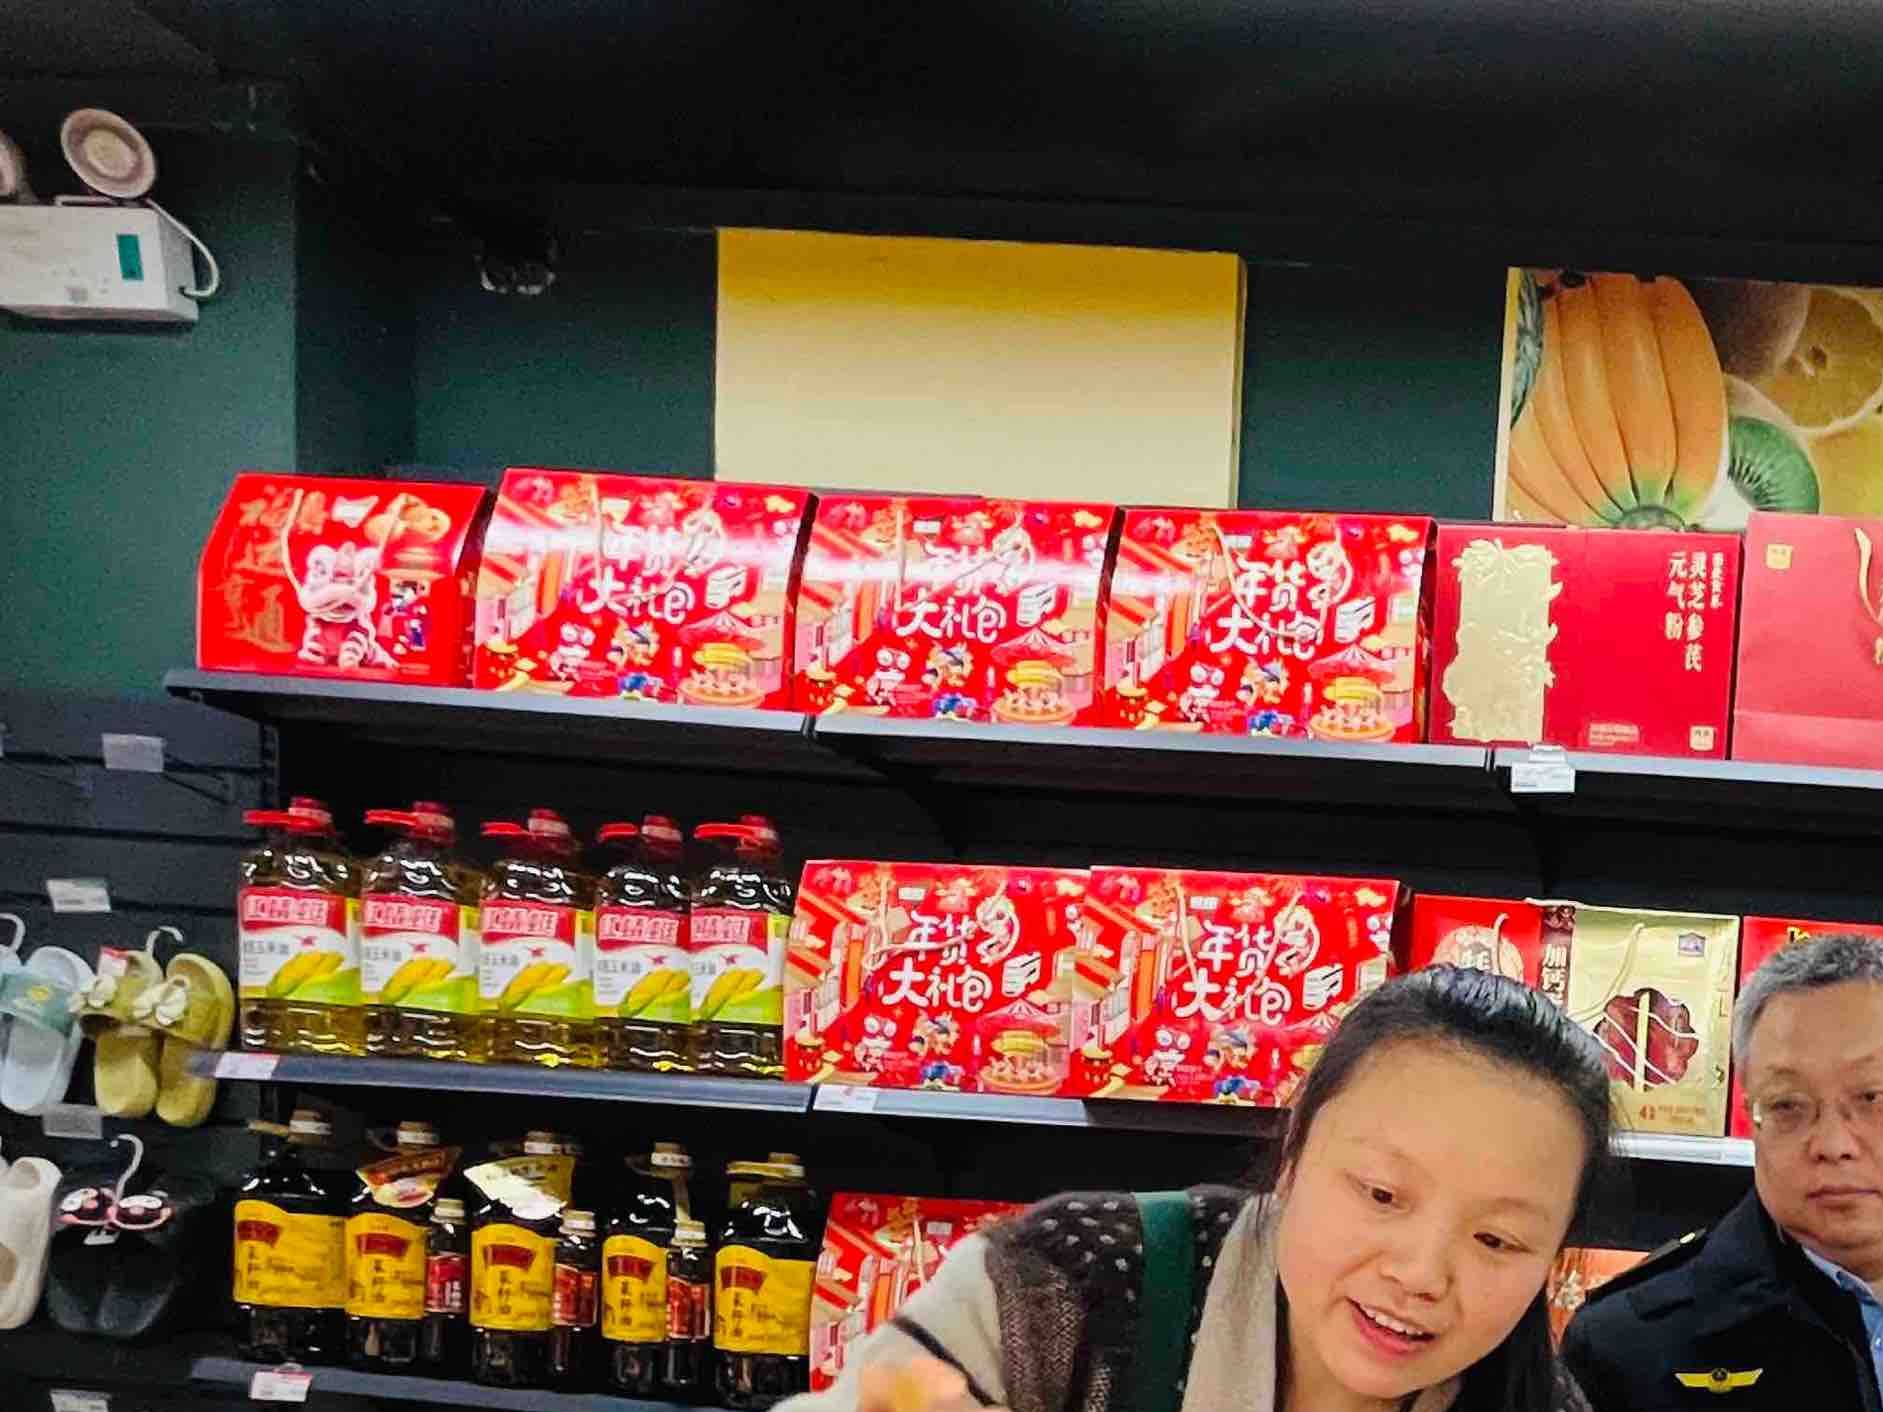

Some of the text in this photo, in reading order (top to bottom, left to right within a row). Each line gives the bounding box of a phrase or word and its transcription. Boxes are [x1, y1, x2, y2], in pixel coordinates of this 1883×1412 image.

[1238, 558, 1310, 613] 年货
[1665, 552, 1688, 640] 元气粉
[897, 595, 1005, 644] 大礼包
[1209, 610, 1322, 660] 大礼包
[1200, 923, 1272, 976] 年货
[882, 967, 991, 1011] 大礼包
[1172, 974, 1291, 1023] 大礼包
